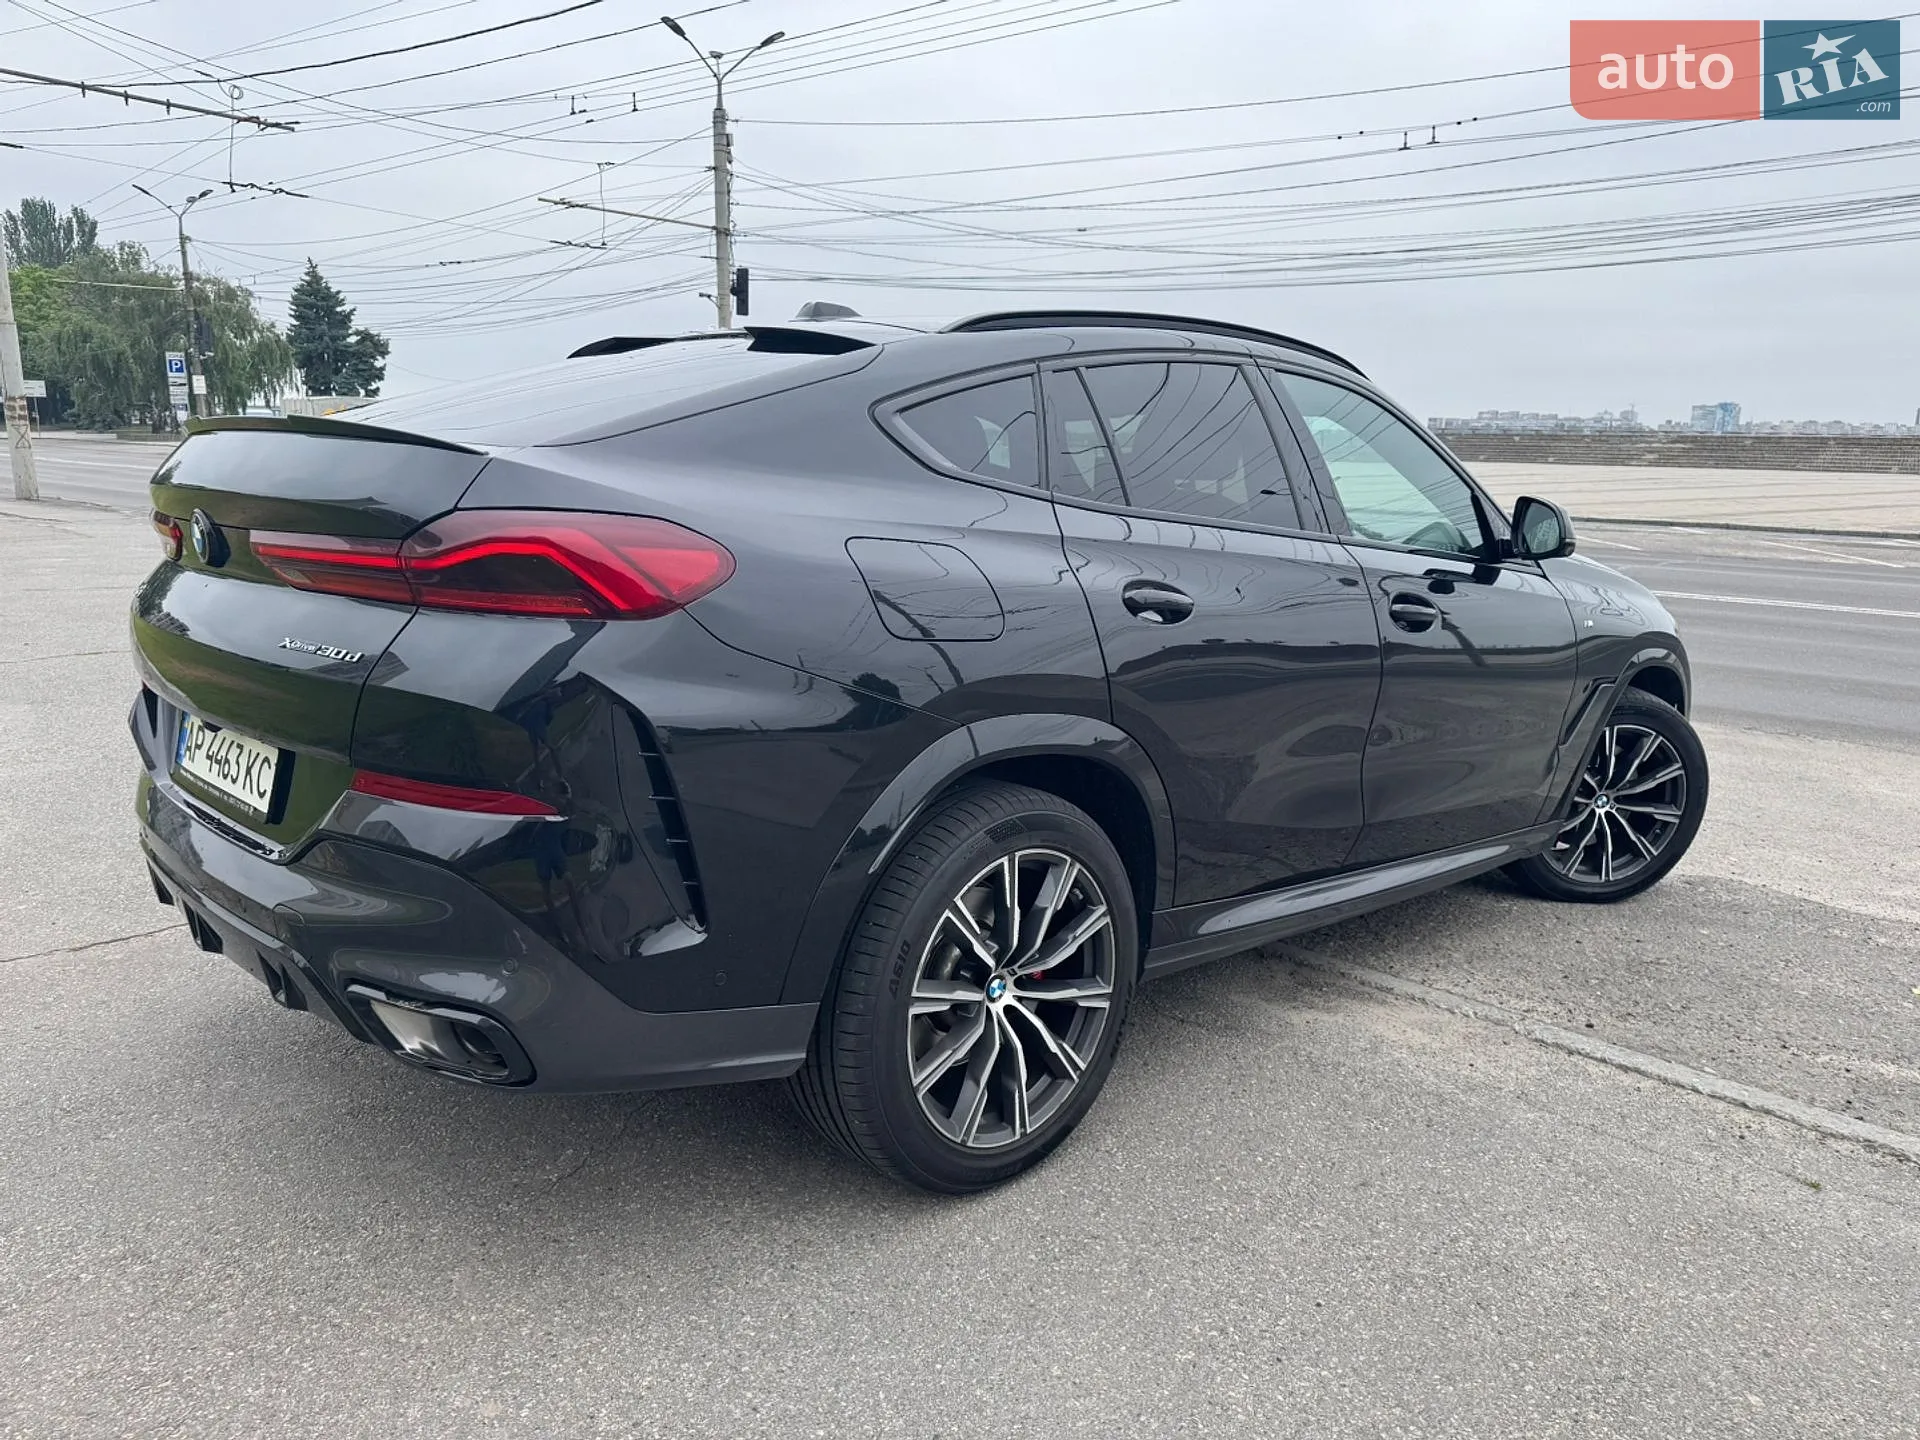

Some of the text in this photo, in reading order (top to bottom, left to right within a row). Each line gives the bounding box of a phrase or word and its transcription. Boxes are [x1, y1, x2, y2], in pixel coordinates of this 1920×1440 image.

[171, 360, 182, 373] P
[184, 721, 206, 763] AP
[205, 732, 244, 785] 4463
[242, 748, 272, 799] KC
